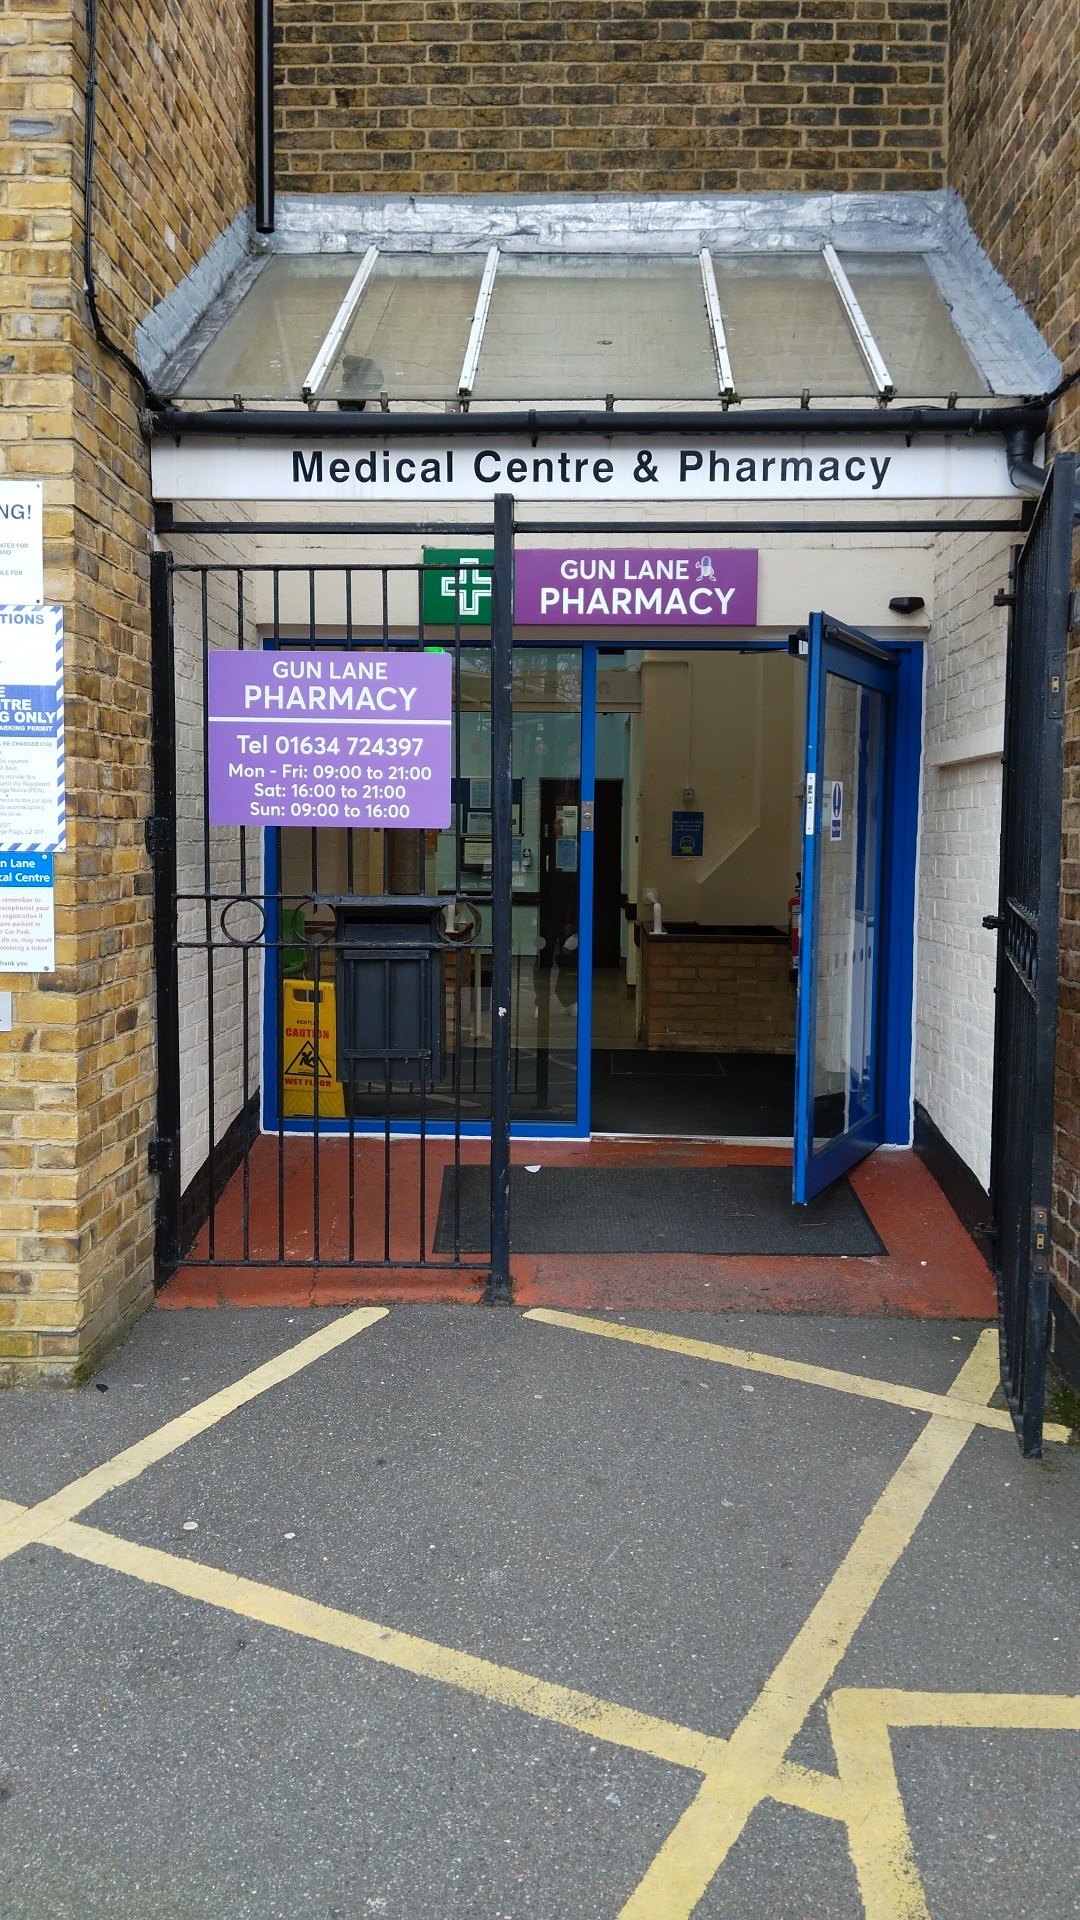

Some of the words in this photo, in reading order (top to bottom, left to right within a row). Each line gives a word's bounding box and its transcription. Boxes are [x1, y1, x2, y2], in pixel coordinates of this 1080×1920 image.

[292, 450, 454, 483] Medical
[473, 450, 614, 483] Centre
[633, 450, 659, 482] &
[679, 450, 892, 489] Pharmacy
[560, 560, 616, 580] GUN
[624, 560, 690, 580] LANE
[540, 588, 736, 615] PHARMACY
[273, 661, 321, 679] GUN
[329, 662, 387, 680] LANE
[245, 685, 417, 711] PHARMACY
[14, 712, 56, 723] ONLY
[237, 735, 268, 754] Tel
[275, 736, 340, 755] 01634
[347, 738, 424, 757] 724397
[228, 763, 264, 778] Mon
[282, 765, 308, 779] Fri:
[313, 766, 361, 780] 09:00
[367, 766, 383, 780] to
[388, 766, 432, 781] 21:00
[254, 783, 286, 797] Sat:
[291, 784, 335, 798] 16:00
[341, 786, 357, 798] to
[362, 786, 406, 799] 21:00
[250, 802, 285, 816] Sun:
[290, 804, 339, 817] 09:00
[344, 805, 360, 818] to
[366, 805, 410, 819] 16:00
[10, 858, 35, 868] Lane
[15, 872, 50, 883] Centre
[305, 1079, 331, 1087] FLOR
